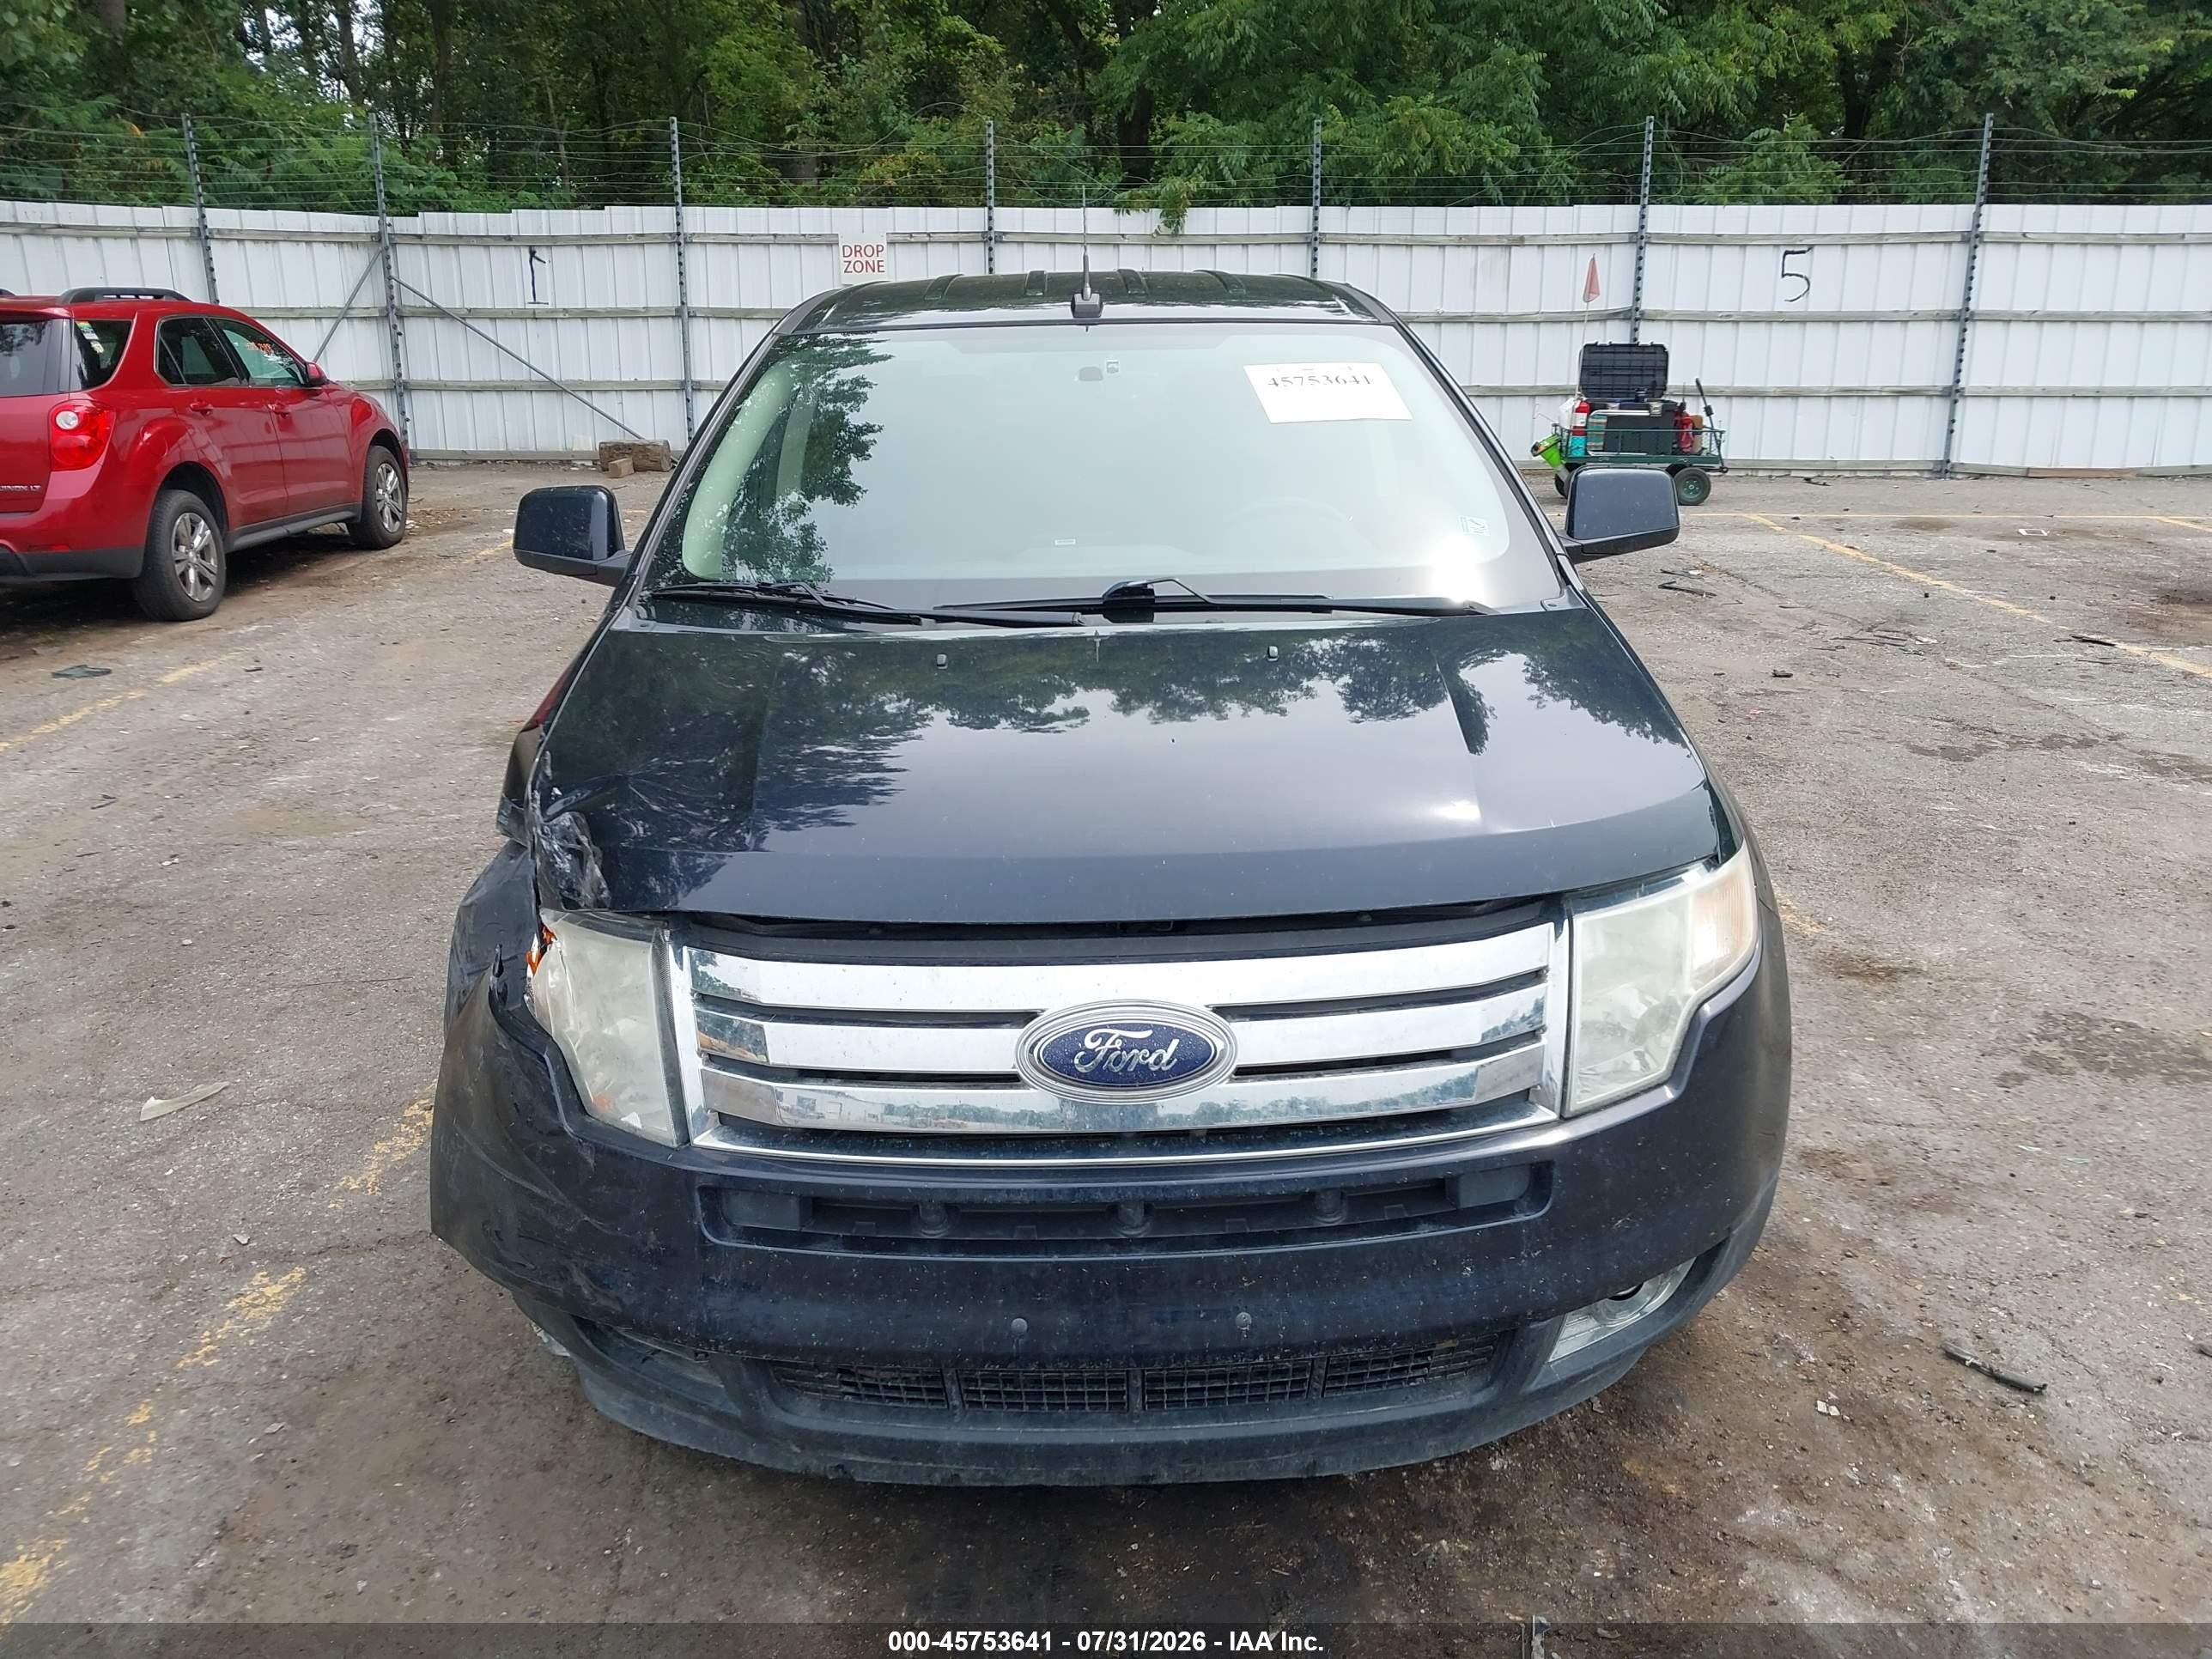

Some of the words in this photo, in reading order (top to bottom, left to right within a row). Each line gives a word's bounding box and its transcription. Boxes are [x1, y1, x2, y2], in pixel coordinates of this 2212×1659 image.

[842, 244, 885, 258] DROP
[842, 259, 886, 274] ZONE
[1781, 246, 1814, 303] 5
[1073, 1029, 1180, 1073] Ford
